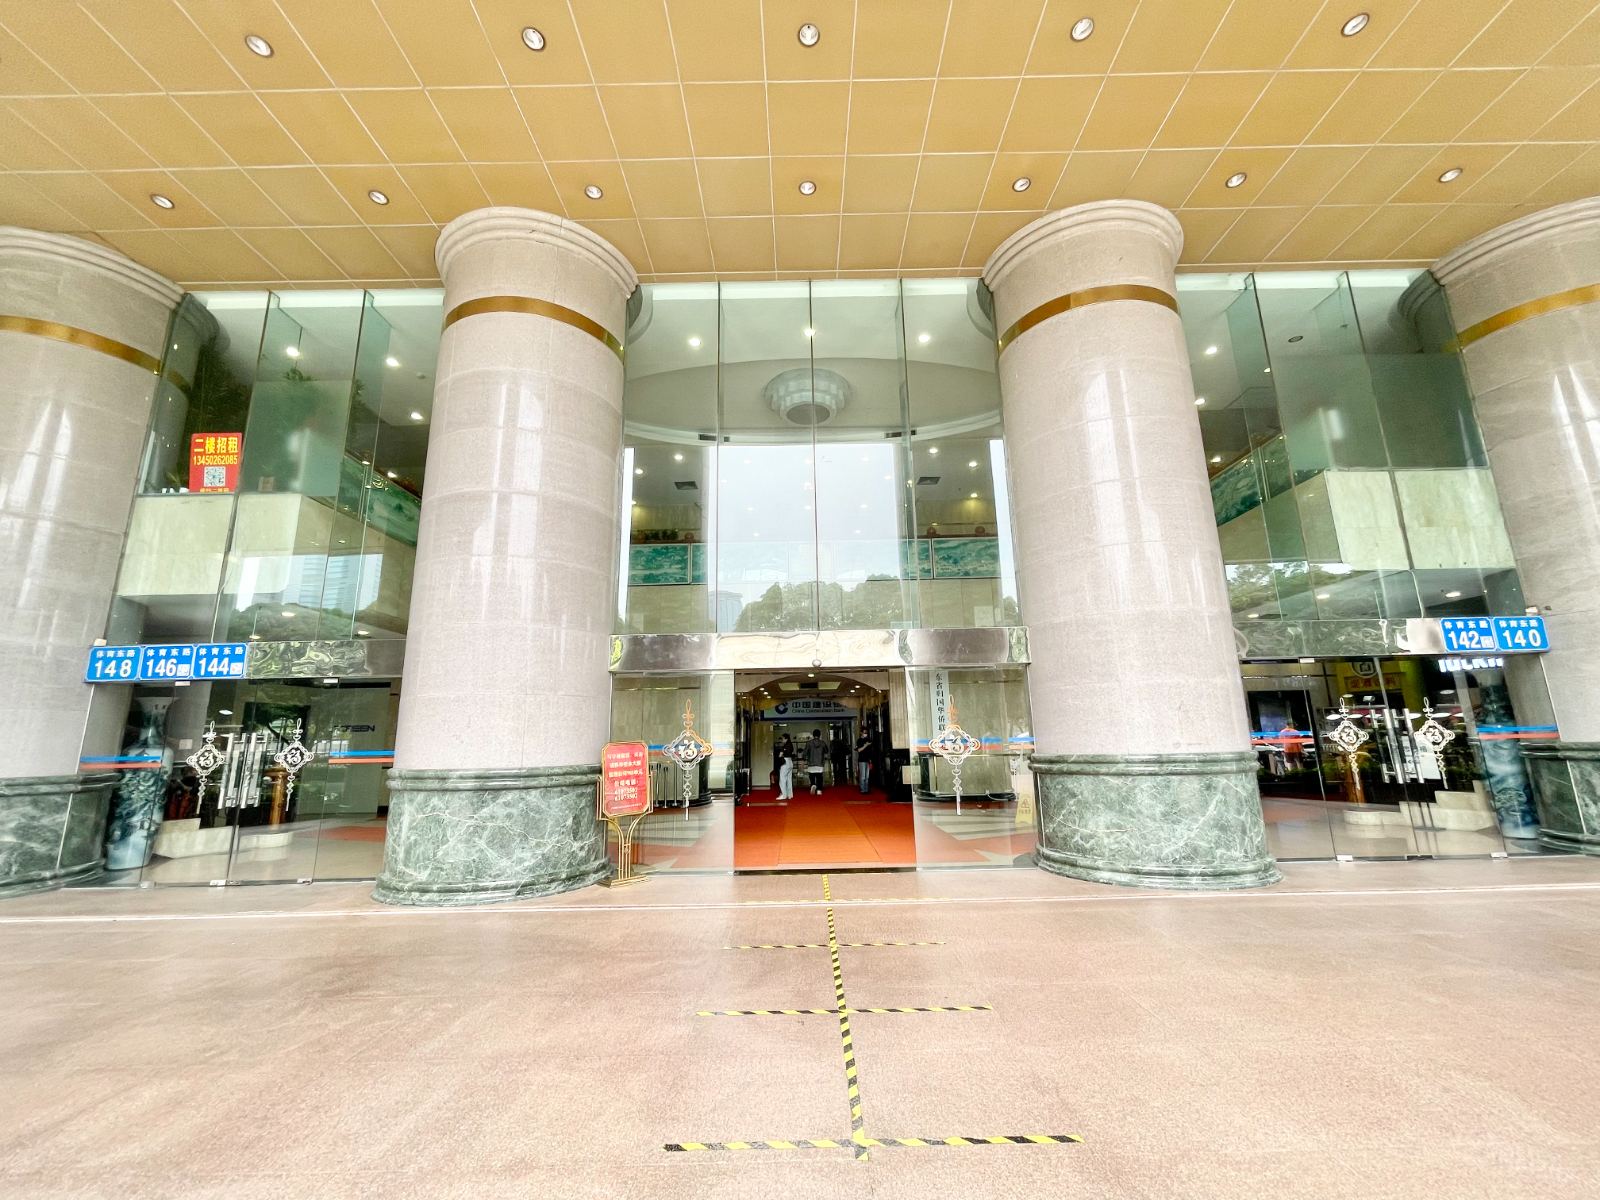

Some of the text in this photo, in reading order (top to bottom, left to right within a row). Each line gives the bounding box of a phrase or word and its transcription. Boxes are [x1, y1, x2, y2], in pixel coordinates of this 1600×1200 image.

[194, 437, 238, 454] 二楼招租
[193, 455, 238, 466] 13450262085
[1444, 620, 1489, 629] 体育东路
[1498, 619, 1538, 628] 体育东路
[1448, 630, 1481, 649] 142
[1502, 629, 1541, 648] 140
[96, 650, 135, 658] 体育东路
[146, 648, 191, 657] 体育东路
[199, 646, 244, 656] 体育东路
[94, 659, 132, 678] 148
[146, 659, 177, 677] 146
[199, 657, 229, 676] 144
